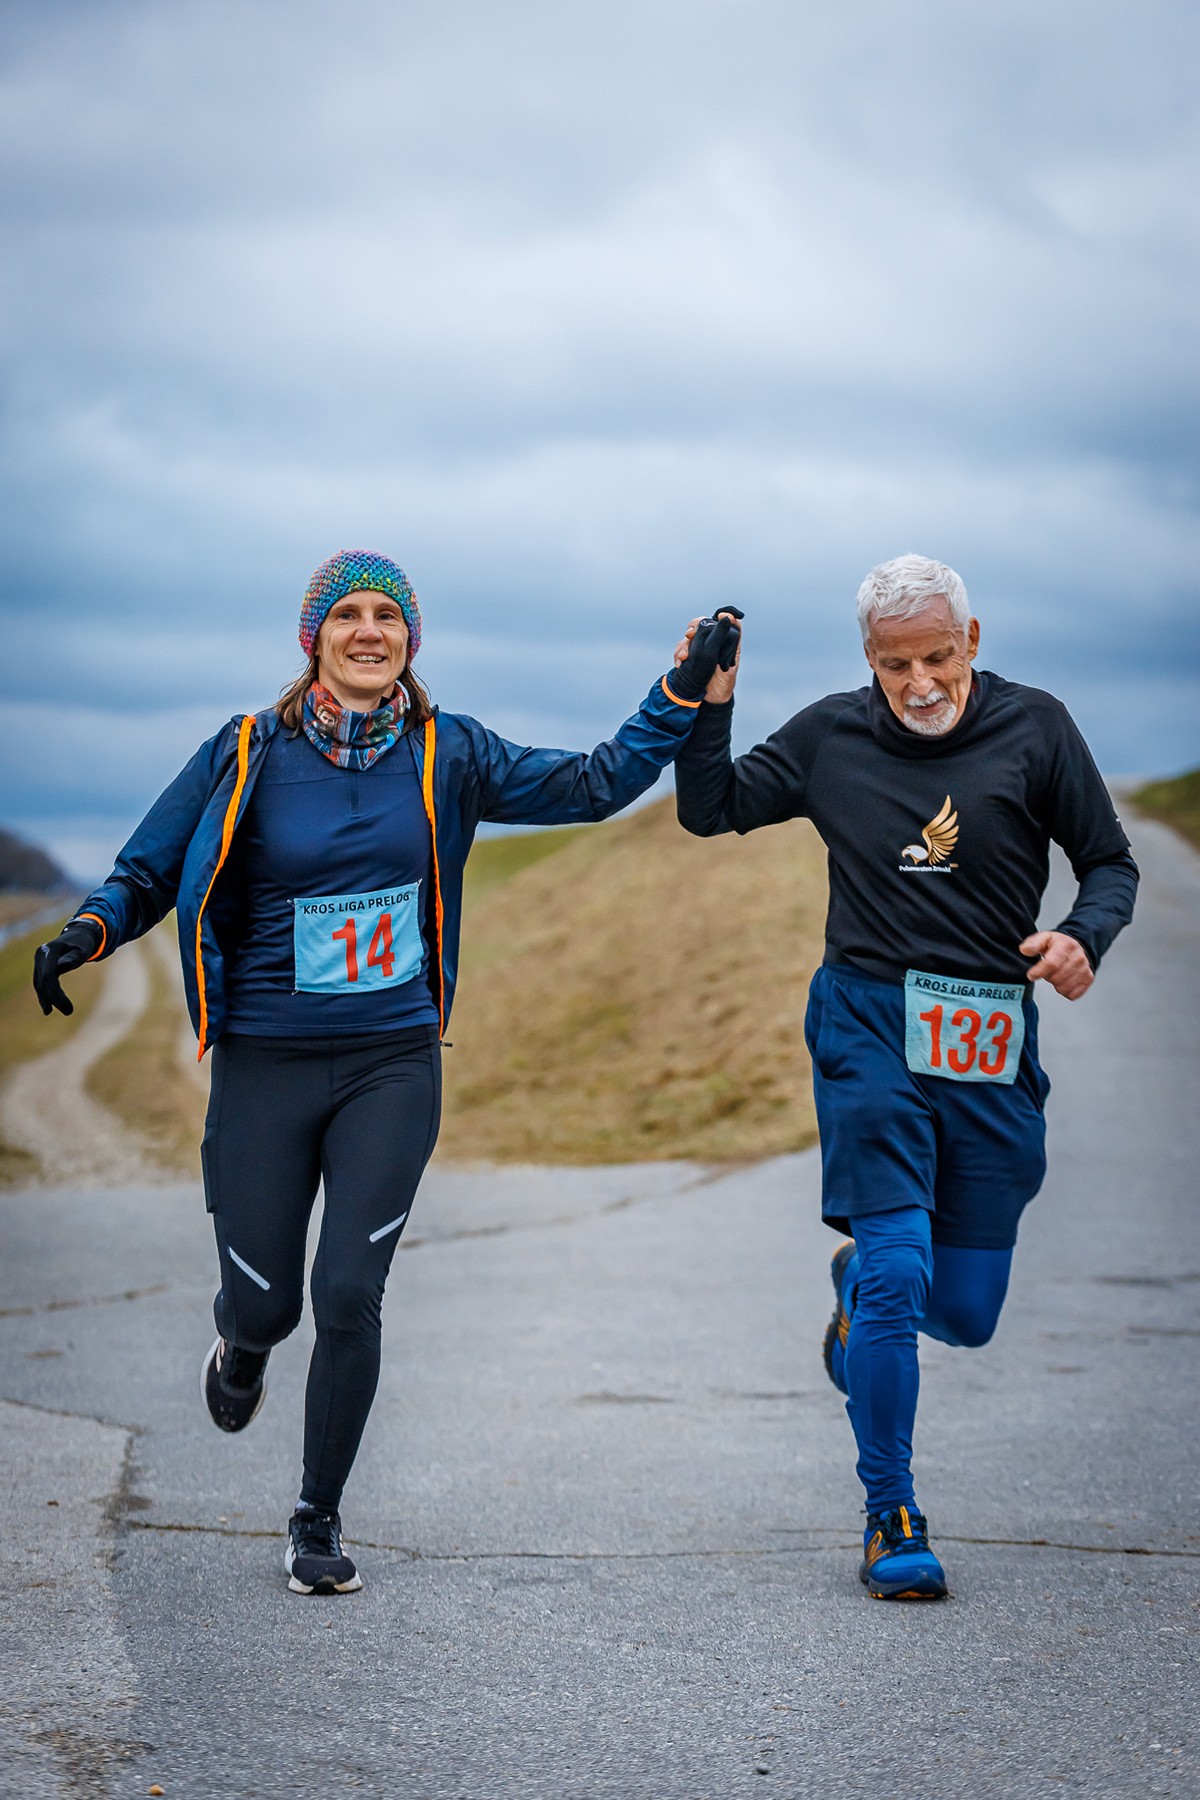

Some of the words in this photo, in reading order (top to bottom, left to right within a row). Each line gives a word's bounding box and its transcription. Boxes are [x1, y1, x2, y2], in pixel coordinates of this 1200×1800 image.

[303, 903, 335, 914] KROS
[338, 901, 366, 912] LIGA
[368, 891, 410, 909] PRELOG
[331, 913, 396, 983] 14
[914, 976, 948, 993] KROS
[951, 984, 976, 997] LIGA
[978, 987, 1016, 1000] PRELOG
[919, 1004, 1013, 1075] 133
